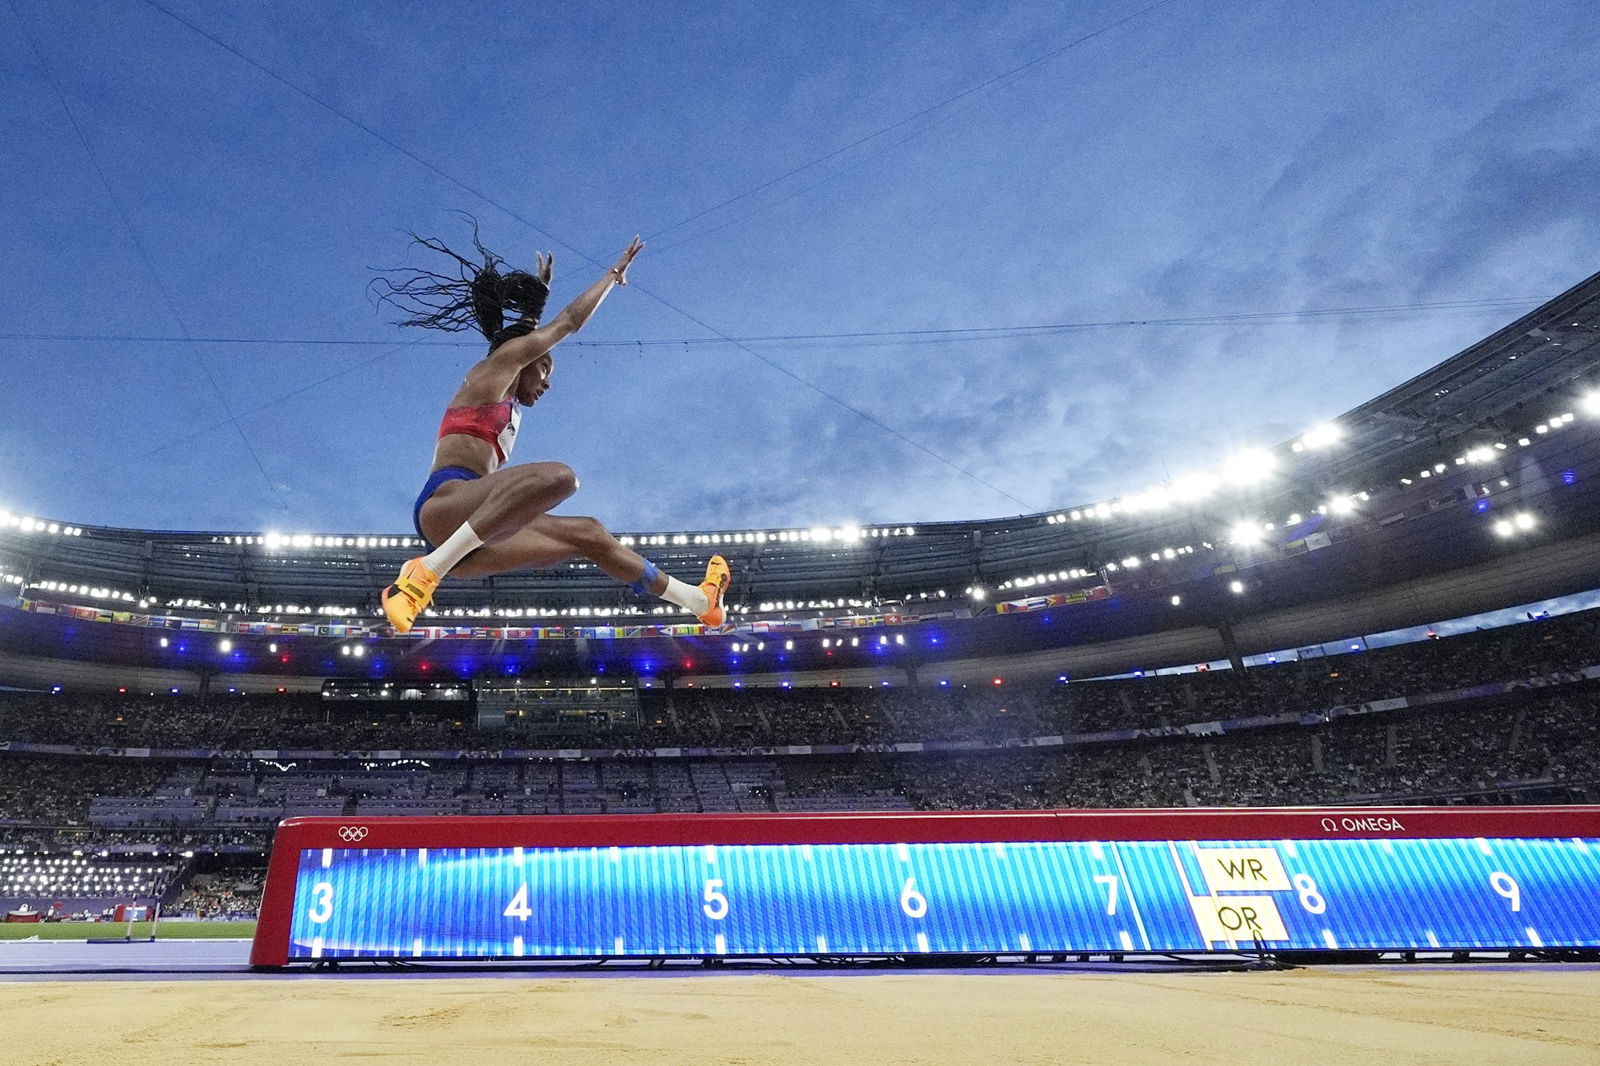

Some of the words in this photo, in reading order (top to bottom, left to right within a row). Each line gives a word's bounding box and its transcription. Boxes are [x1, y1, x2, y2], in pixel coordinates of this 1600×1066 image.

[1341, 817, 1406, 832] OMEGA
[1217, 858, 1268, 881] WR
[309, 882, 333, 923] 3
[504, 881, 532, 921] 4
[704, 879, 729, 920] 5
[901, 877, 928, 918] 6
[1093, 875, 1118, 916] 7
[1293, 873, 1327, 915] 8
[1489, 871, 1521, 912] 9
[1217, 906, 1263, 931] OR
